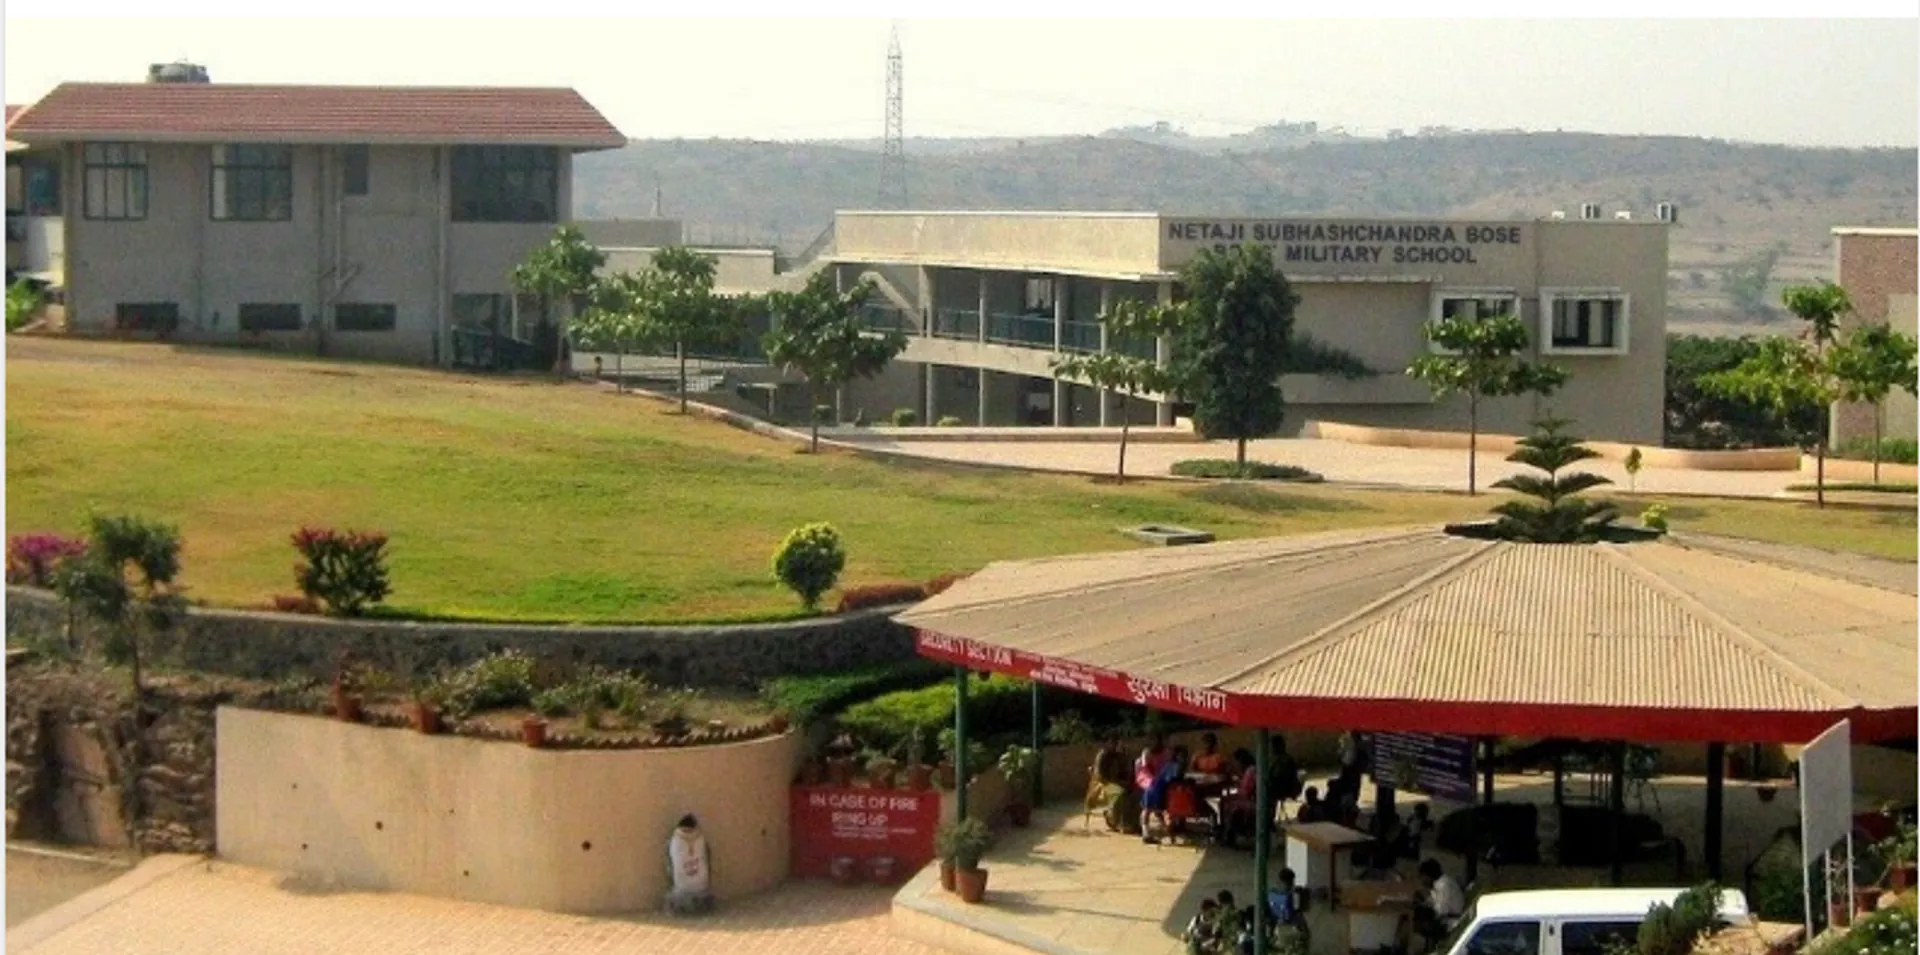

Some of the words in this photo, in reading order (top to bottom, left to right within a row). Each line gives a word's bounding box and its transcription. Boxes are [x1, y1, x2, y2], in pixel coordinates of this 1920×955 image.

[1168, 222, 1244, 241] NETAJI
[1253, 222, 1456, 243] SUBHASHCHANDRA
[1465, 226, 1521, 244] BOSE
[1285, 244, 1382, 264] MILITARY
[1392, 246, 1478, 264] SCHOOL
[809, 793, 826, 807] IN
[829, 794, 866, 809] CASE
[868, 796, 887, 809] OF
[889, 797, 917, 811] FIRE
